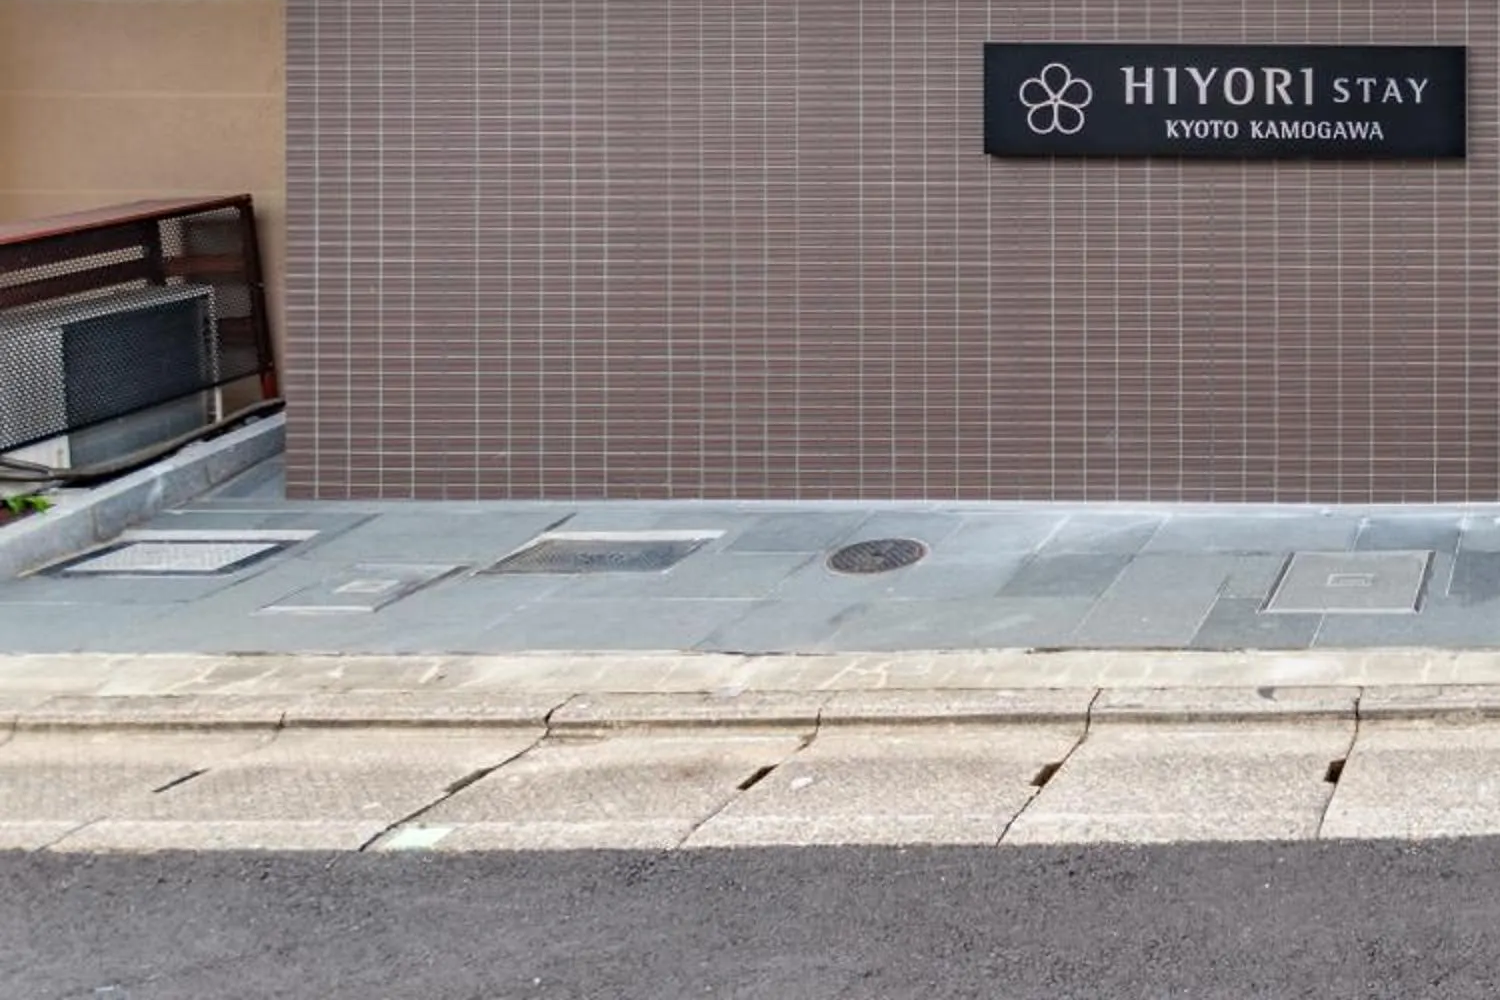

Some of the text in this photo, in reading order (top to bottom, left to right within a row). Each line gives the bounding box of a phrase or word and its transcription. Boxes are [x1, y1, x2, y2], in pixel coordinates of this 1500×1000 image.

[1119, 66, 1430, 106] HIYORI STAY
[1165, 119, 1385, 141] KYOTO KAMOGAWA
